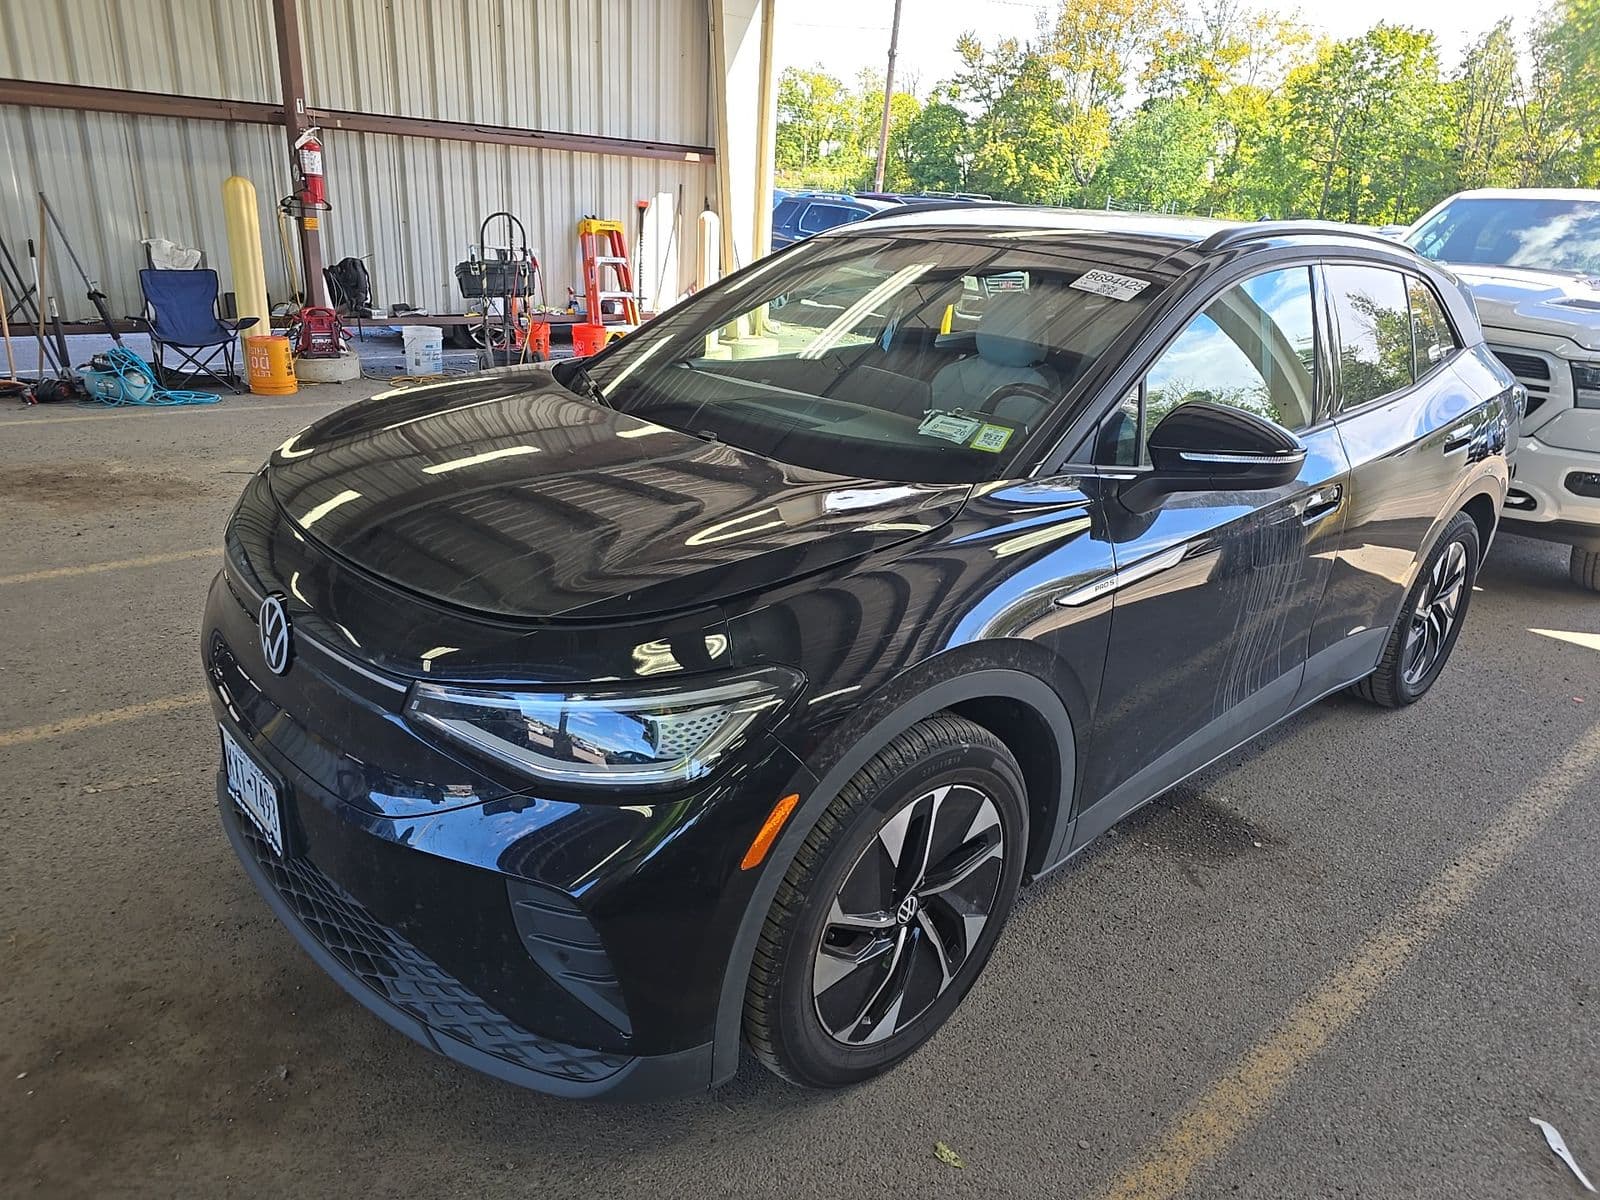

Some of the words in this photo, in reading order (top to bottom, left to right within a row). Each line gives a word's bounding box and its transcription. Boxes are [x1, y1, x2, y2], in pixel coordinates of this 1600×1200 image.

[1086, 271, 1147, 292] 8694425
[251, 356, 270, 370] DO
[1094, 581, 1109, 592] PRO
